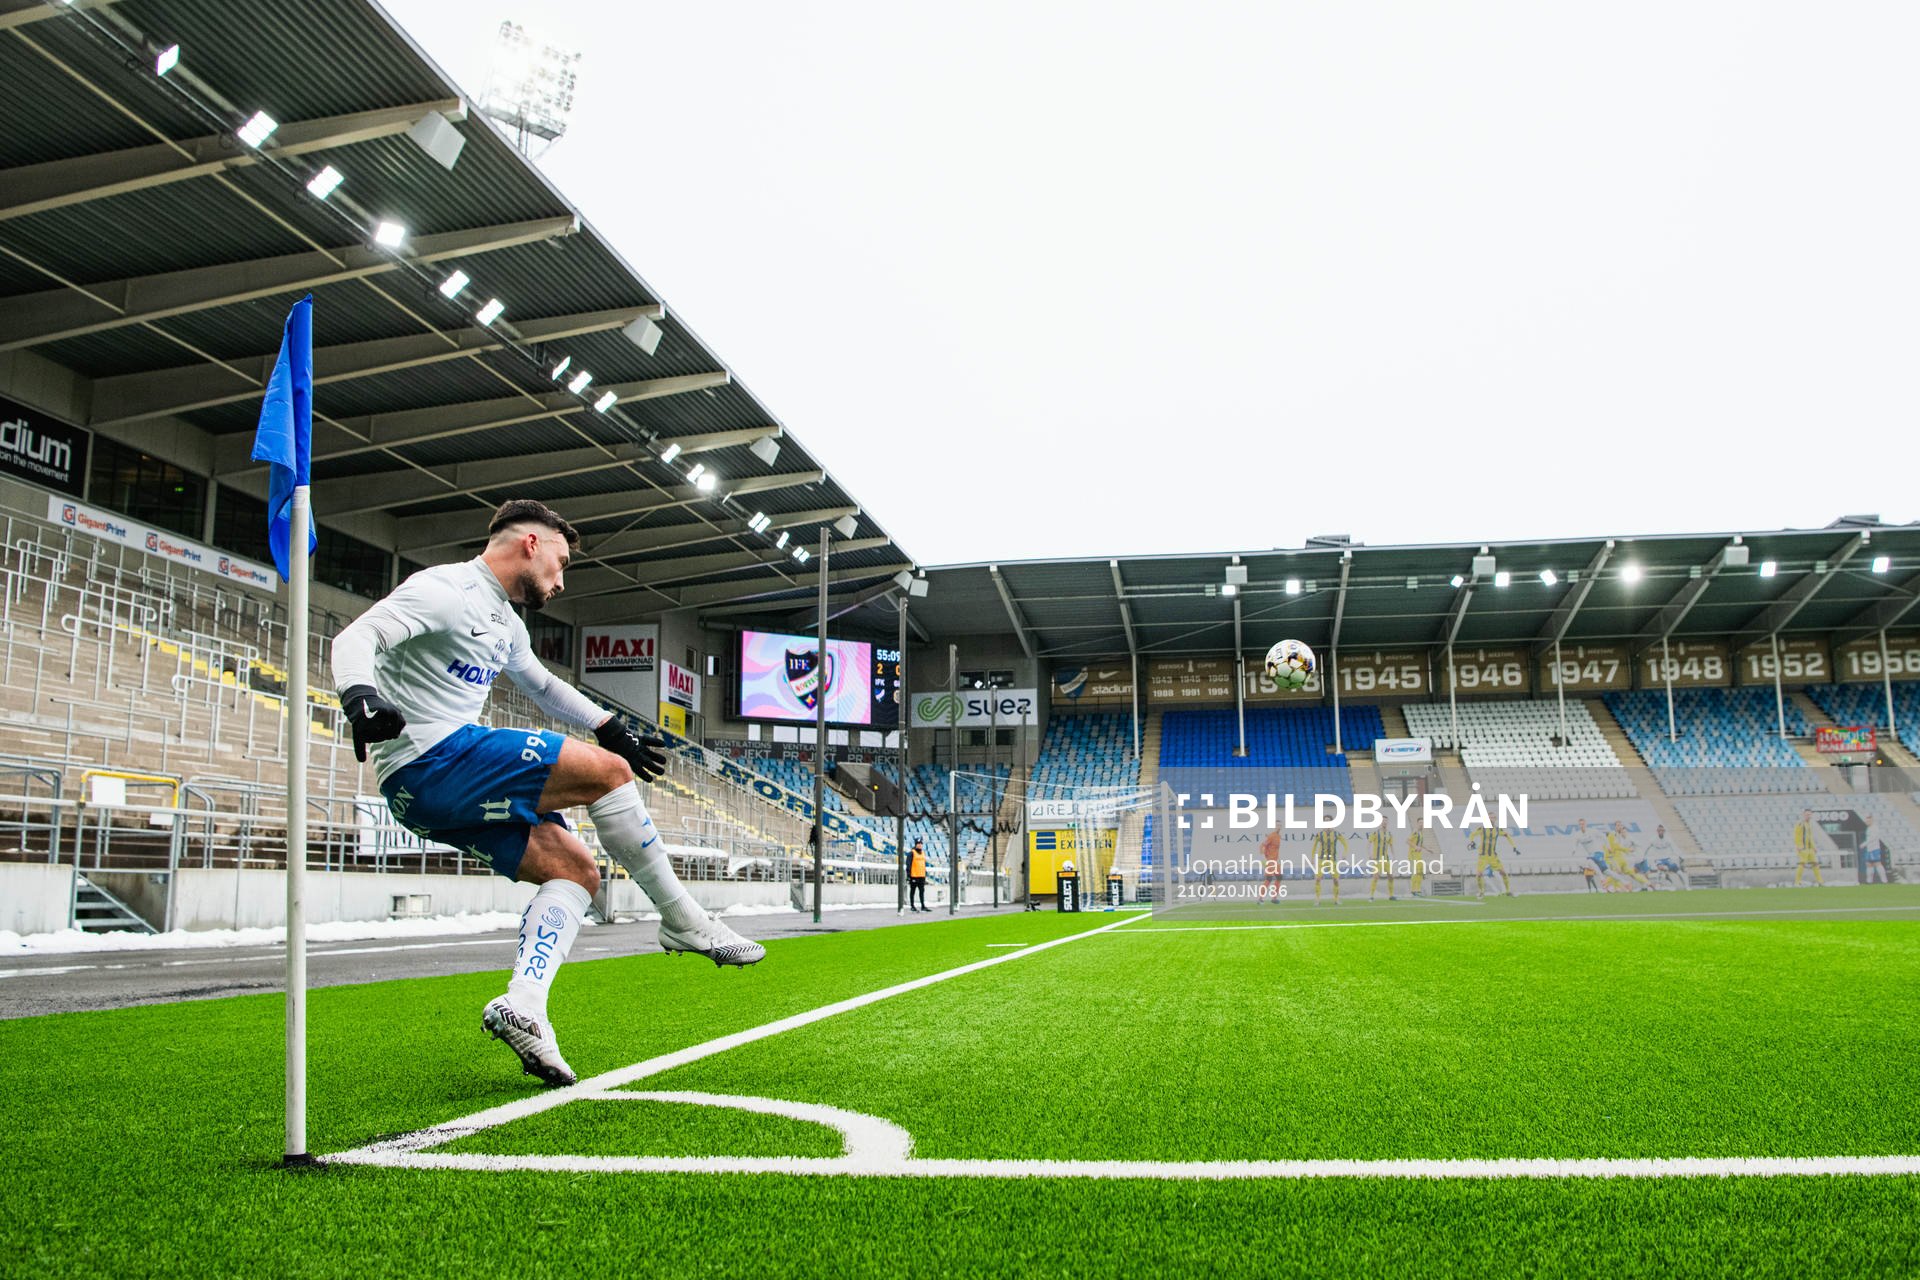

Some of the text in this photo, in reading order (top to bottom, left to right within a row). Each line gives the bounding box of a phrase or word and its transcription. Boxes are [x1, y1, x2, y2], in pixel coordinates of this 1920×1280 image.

[27, 460, 69, 483] movement
[77, 513, 127, 539] GigantPrint
[158, 540, 202, 563] GigantPrint
[230, 563, 268, 585] GigantPrint
[586, 635, 654, 659] MAXI
[598, 657, 654, 667] STORMARKNAD
[1547, 659, 1620, 685] 1947
[1646, 656, 1723, 681] 1948
[1747, 652, 1825, 678] 1952
[669, 664, 693, 695] MAXI
[1339, 665, 1421, 691] 1945
[1446, 663, 1522, 688] 1946
[968, 698, 1031, 717] suez
[714, 740, 772, 749] VENTILATIONS
[782, 752, 837, 762] PROJKT
[1063, 880, 1073, 911] SELECT
[524, 925, 558, 980] suez
